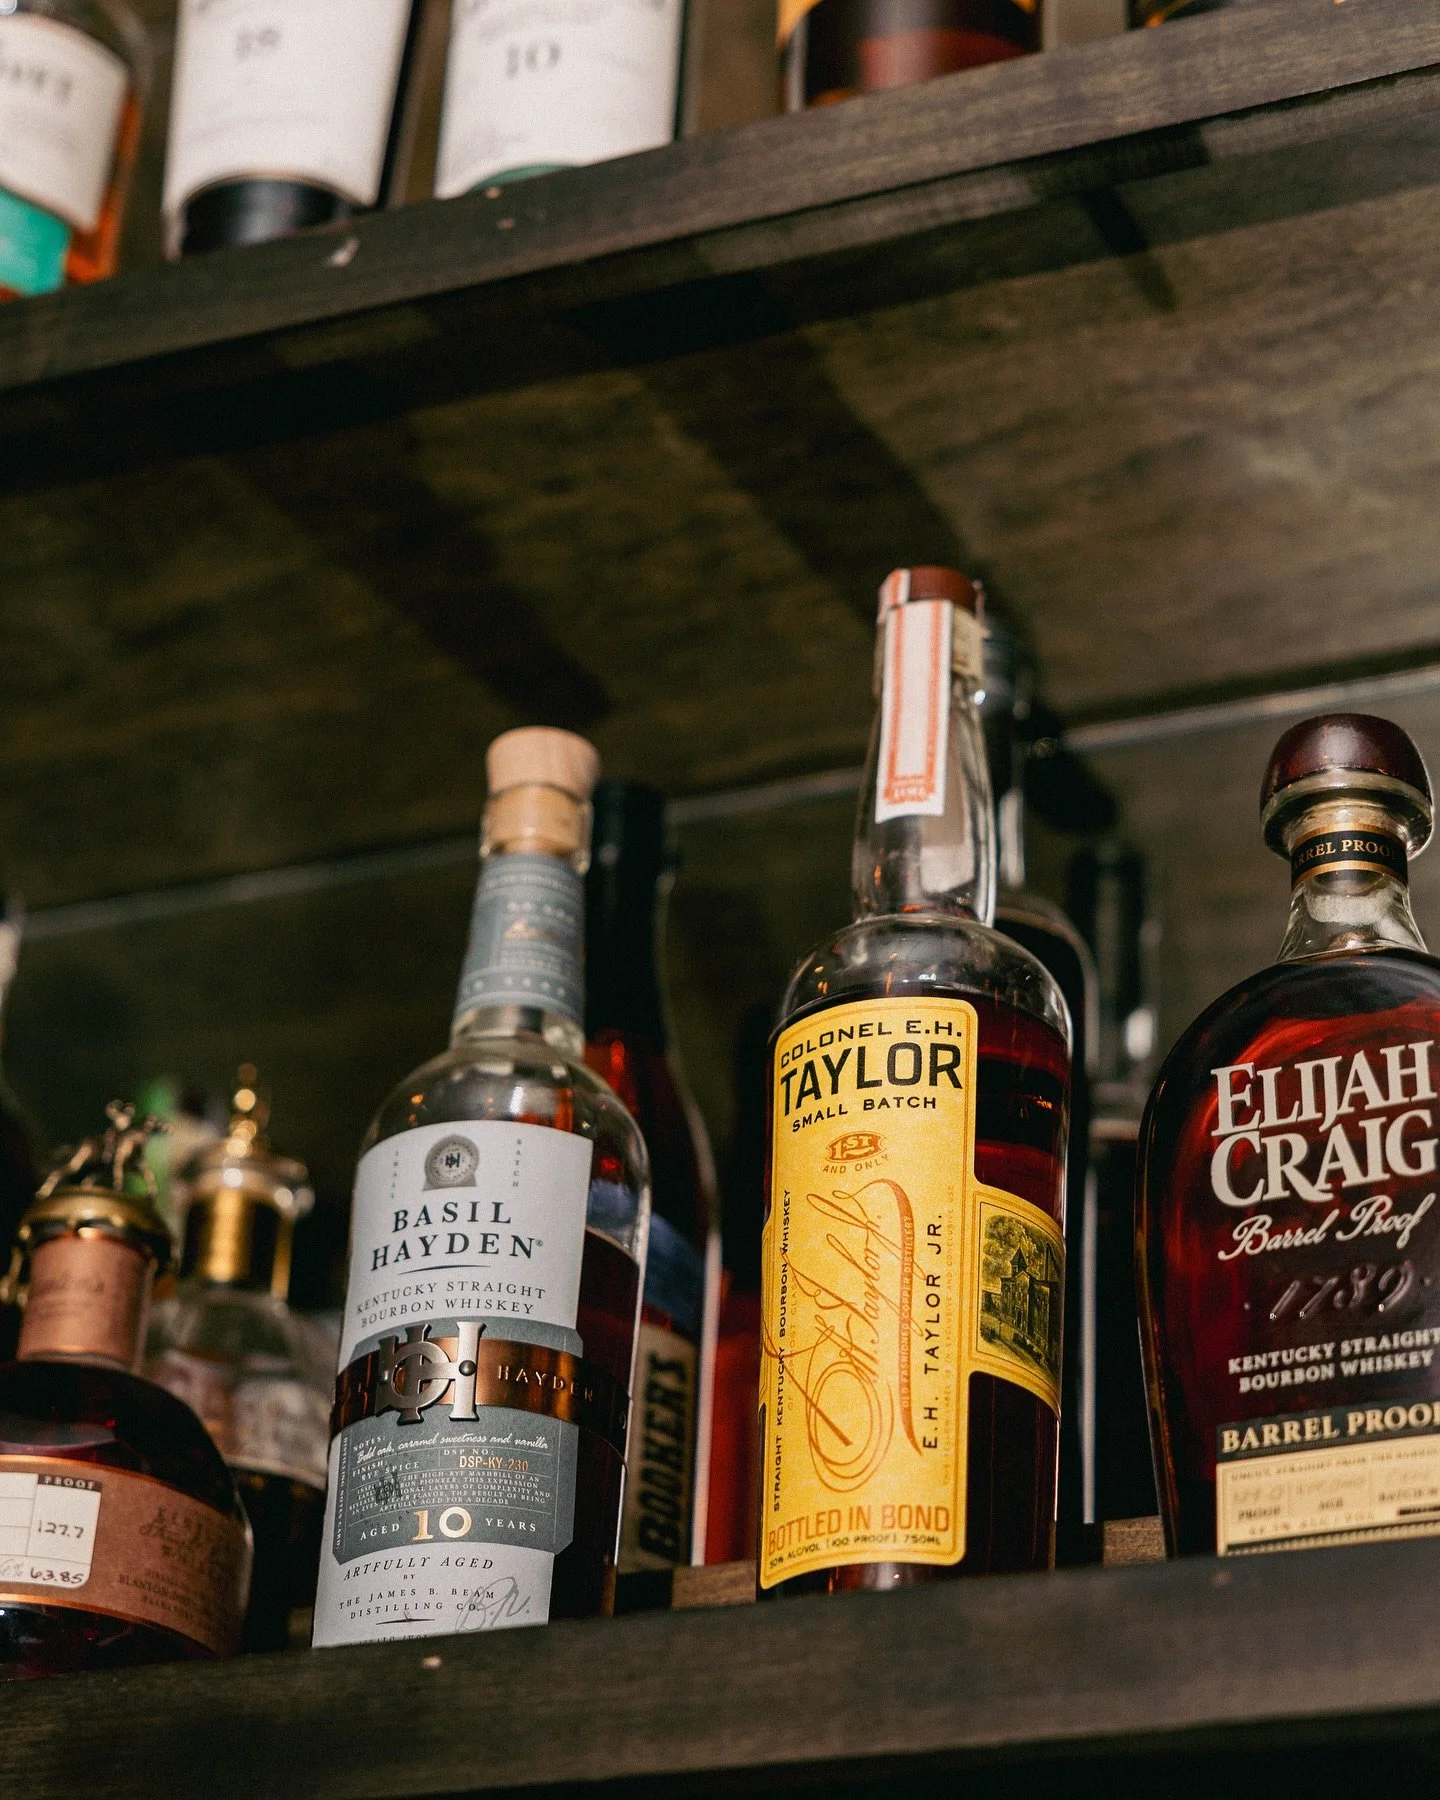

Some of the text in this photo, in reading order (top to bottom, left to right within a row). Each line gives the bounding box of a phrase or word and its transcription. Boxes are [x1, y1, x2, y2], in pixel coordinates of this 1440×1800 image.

[781, 1020, 963, 1069] COLONEL E.H.
[780, 1041, 964, 1118] TAYLOR
[1210, 1039, 1439, 1137] ELIJAH
[792, 1096, 937, 1133] SMALL BATCH
[822, 1153, 889, 1174] AND ONLY
[1209, 1108, 1439, 1208] CRAIG
[391, 1201, 512, 1233] BASIL
[1217, 1192, 1437, 1261] Barrel Proof
[357, 1281, 546, 1315] KENTUCKY STRAIGHT
[360, 1298, 535, 1329] BOURBON WHISKEY
[923, 1215, 942, 1449] E.H. TAYLOR JR.
[773, 1189, 791, 1512] STRAIGHT KENTUCKY BOURBON WHISKEY
[1228, 1327, 1440, 1375] KENTUCKY STRAIGHT
[1238, 1348, 1435, 1394] BOURBON WHISKEY
[356, 1445, 377, 1464] Bold
[398, 1432, 440, 1450] caramel
[439, 1432, 487, 1445] sweetness
[489, 1432, 513, 1444] and
[514, 1435, 549, 1449] vanilla
[1221, 1414, 1341, 1454] BARREL
[443, 1448, 465, 1456] DSP
[459, 1455, 529, 1473] DSP-KY-230
[361, 1461, 420, 1482] RYE SPICE
[464, 1476, 484, 1484] THIS
[487, 1477, 538, 1489] EXPRESSION
[468, 1470, 512, 1479] MASHBILL
[420, 1497, 443, 1506] AGED
[476, 1496, 509, 1506] DECADE
[428, 1483, 459, 1491] LAYERS
[477, 1484, 531, 1494] COMPLEXITY
[533, 1490, 551, 1498] AND
[472, 1490, 504, 1498] RESULT
[521, 1494, 546, 1504] BEING
[37, 1520, 84, 1539] 127.7
[359, 1506, 538, 1541] AGED 10 YEARS
[768, 1503, 950, 1557] BOTTLED IN BOND
[903, 1533, 942, 1546] 750ML
[30, 1567, 84, 1584] 63.85
[343, 1556, 494, 1582] ARTFULLY AGED
[402, 1573, 417, 1581] BY
[339, 1587, 495, 1610] THE JAMES B. BEAM
[350, 1602, 481, 1620] DISTILLING CO.
